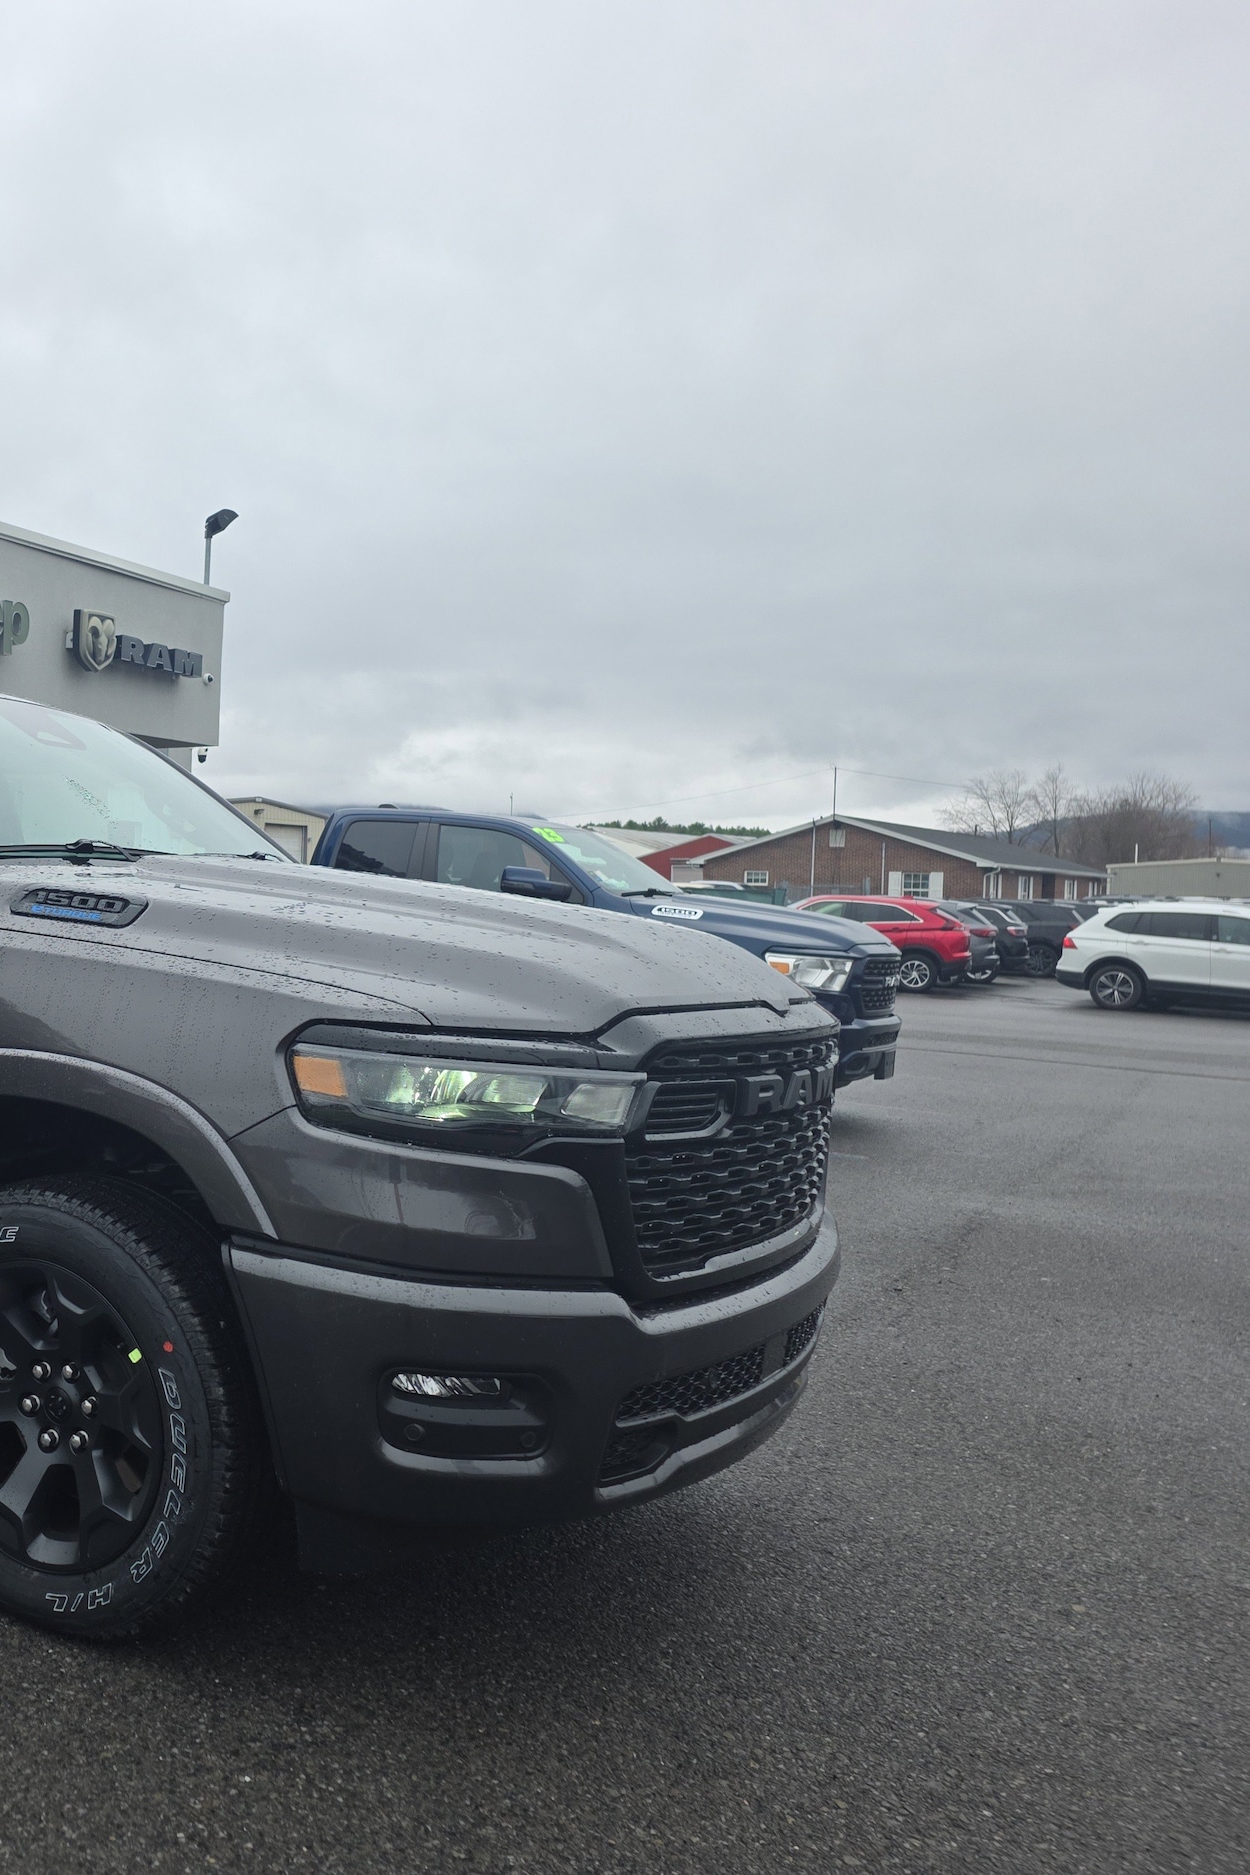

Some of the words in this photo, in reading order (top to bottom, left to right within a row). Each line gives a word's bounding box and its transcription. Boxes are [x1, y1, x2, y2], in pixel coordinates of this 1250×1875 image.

[115, 634, 203, 678] RAM
[34, 890, 125, 914] 1500
[743, 1062, 835, 1117] RAM
[130, 1366, 187, 1584] DUELER
